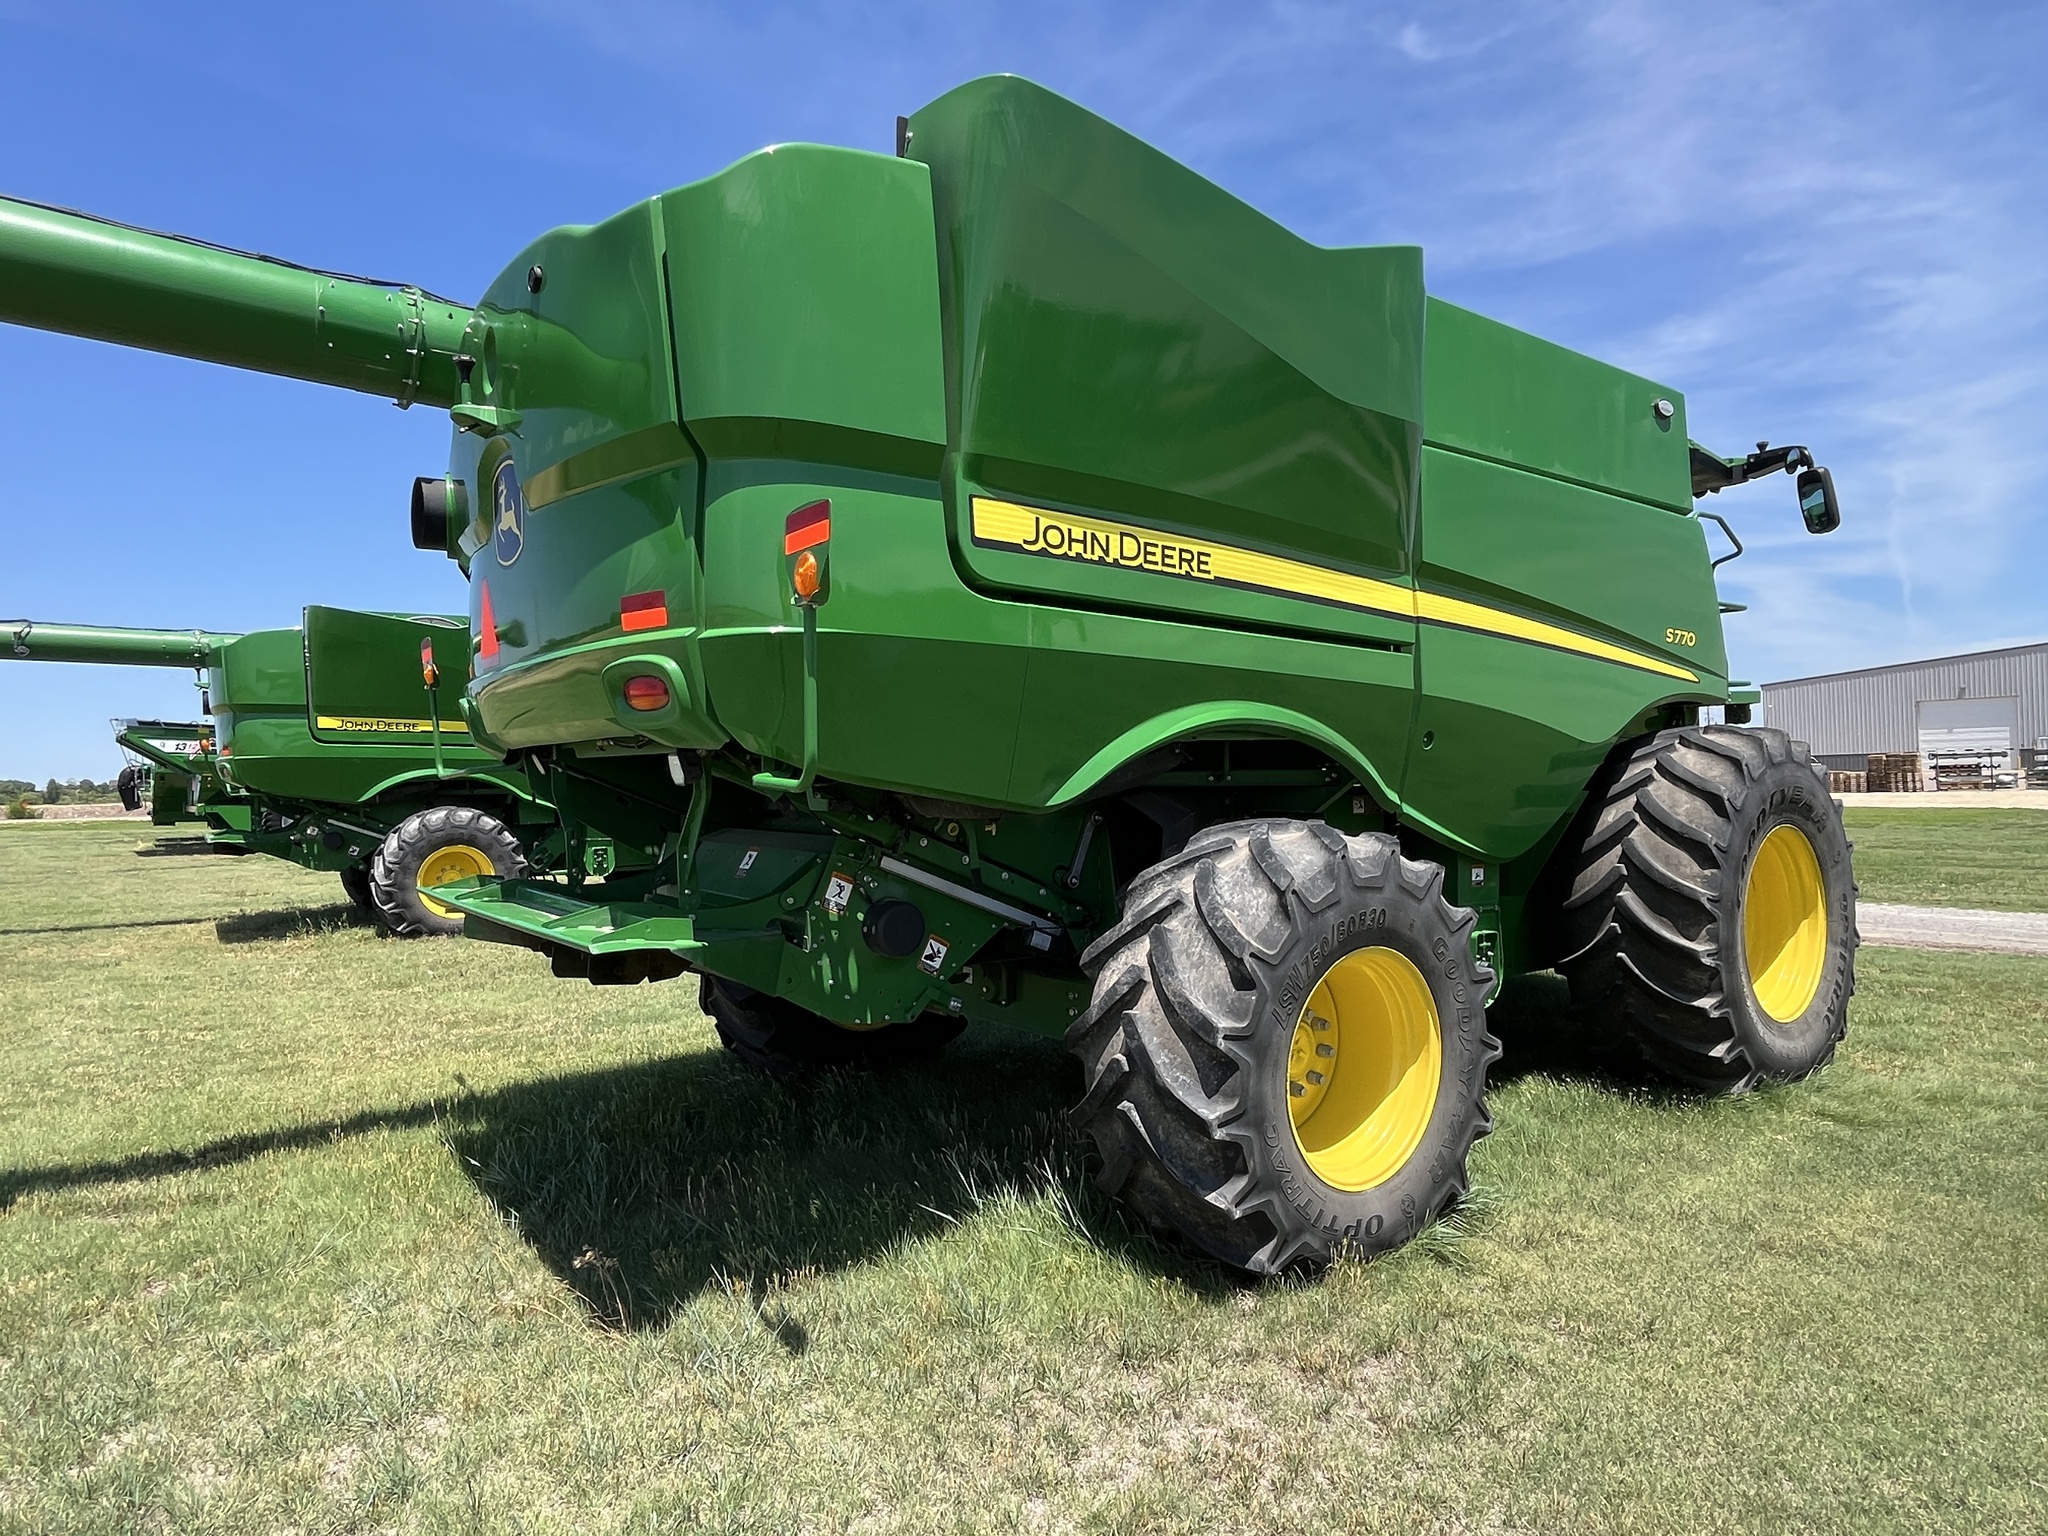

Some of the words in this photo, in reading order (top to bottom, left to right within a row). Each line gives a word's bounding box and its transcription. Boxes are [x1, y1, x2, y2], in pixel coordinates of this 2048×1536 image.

[1022, 516, 1110, 559] JOHN
[1119, 530, 1212, 576] DEERE
[1665, 626, 1696, 648] S770
[337, 719, 373, 730] JOHN
[376, 720, 419, 731] DEERE
[1427, 937, 1474, 1185] GOODYEAR
[1264, 1123, 1384, 1239] OPTITRAC
